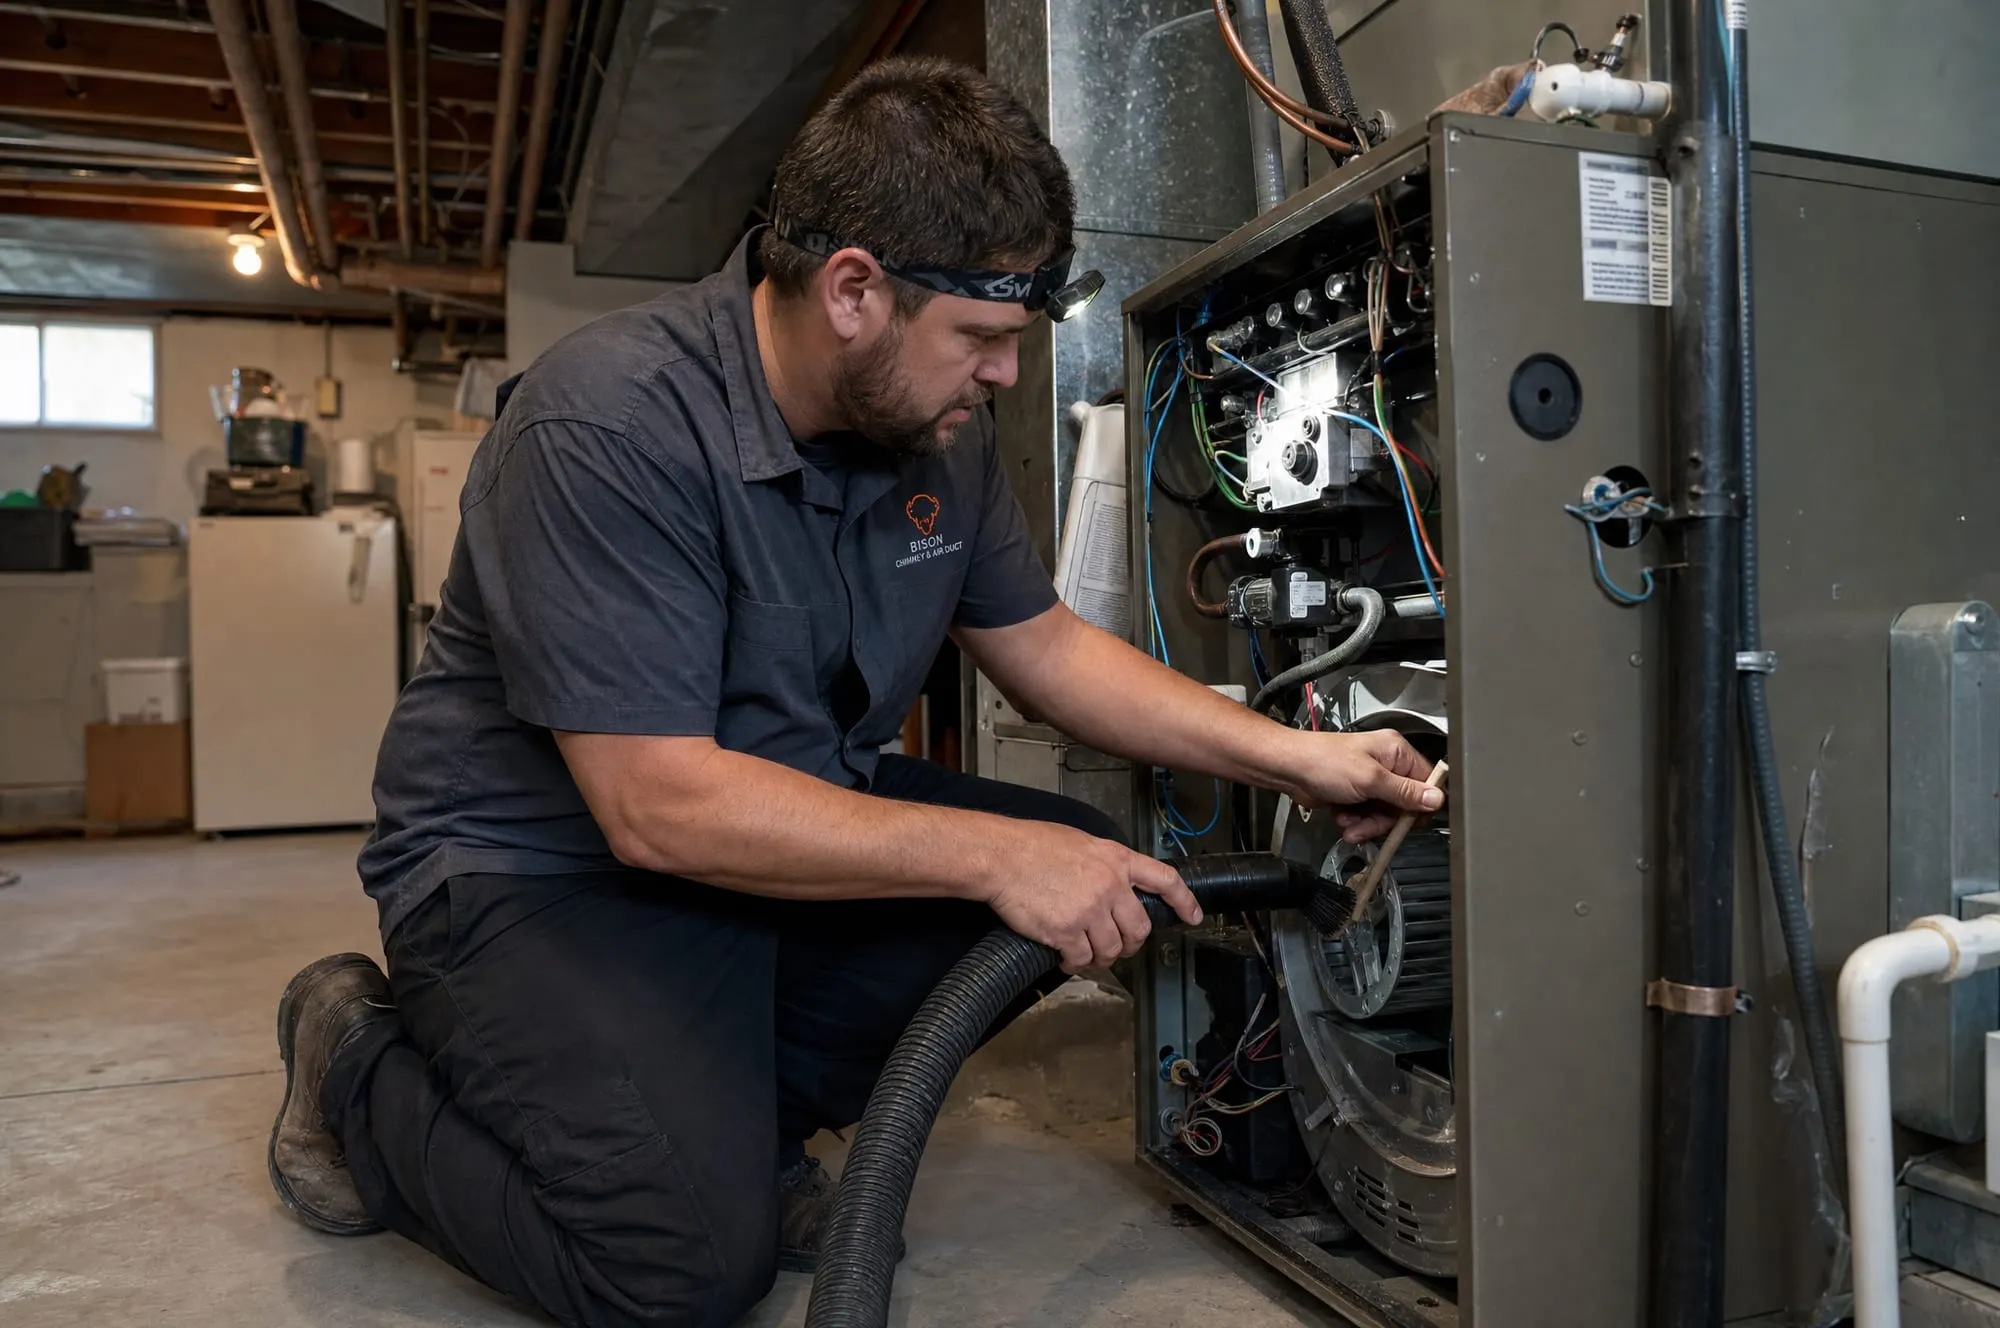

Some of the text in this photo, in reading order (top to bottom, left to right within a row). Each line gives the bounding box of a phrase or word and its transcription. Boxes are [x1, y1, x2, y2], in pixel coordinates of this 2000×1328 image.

[910, 534, 943, 553] BISON
[926, 551, 931, 559] &
[932, 547, 944, 557] AIR
[945, 541, 962, 553] DUCT
